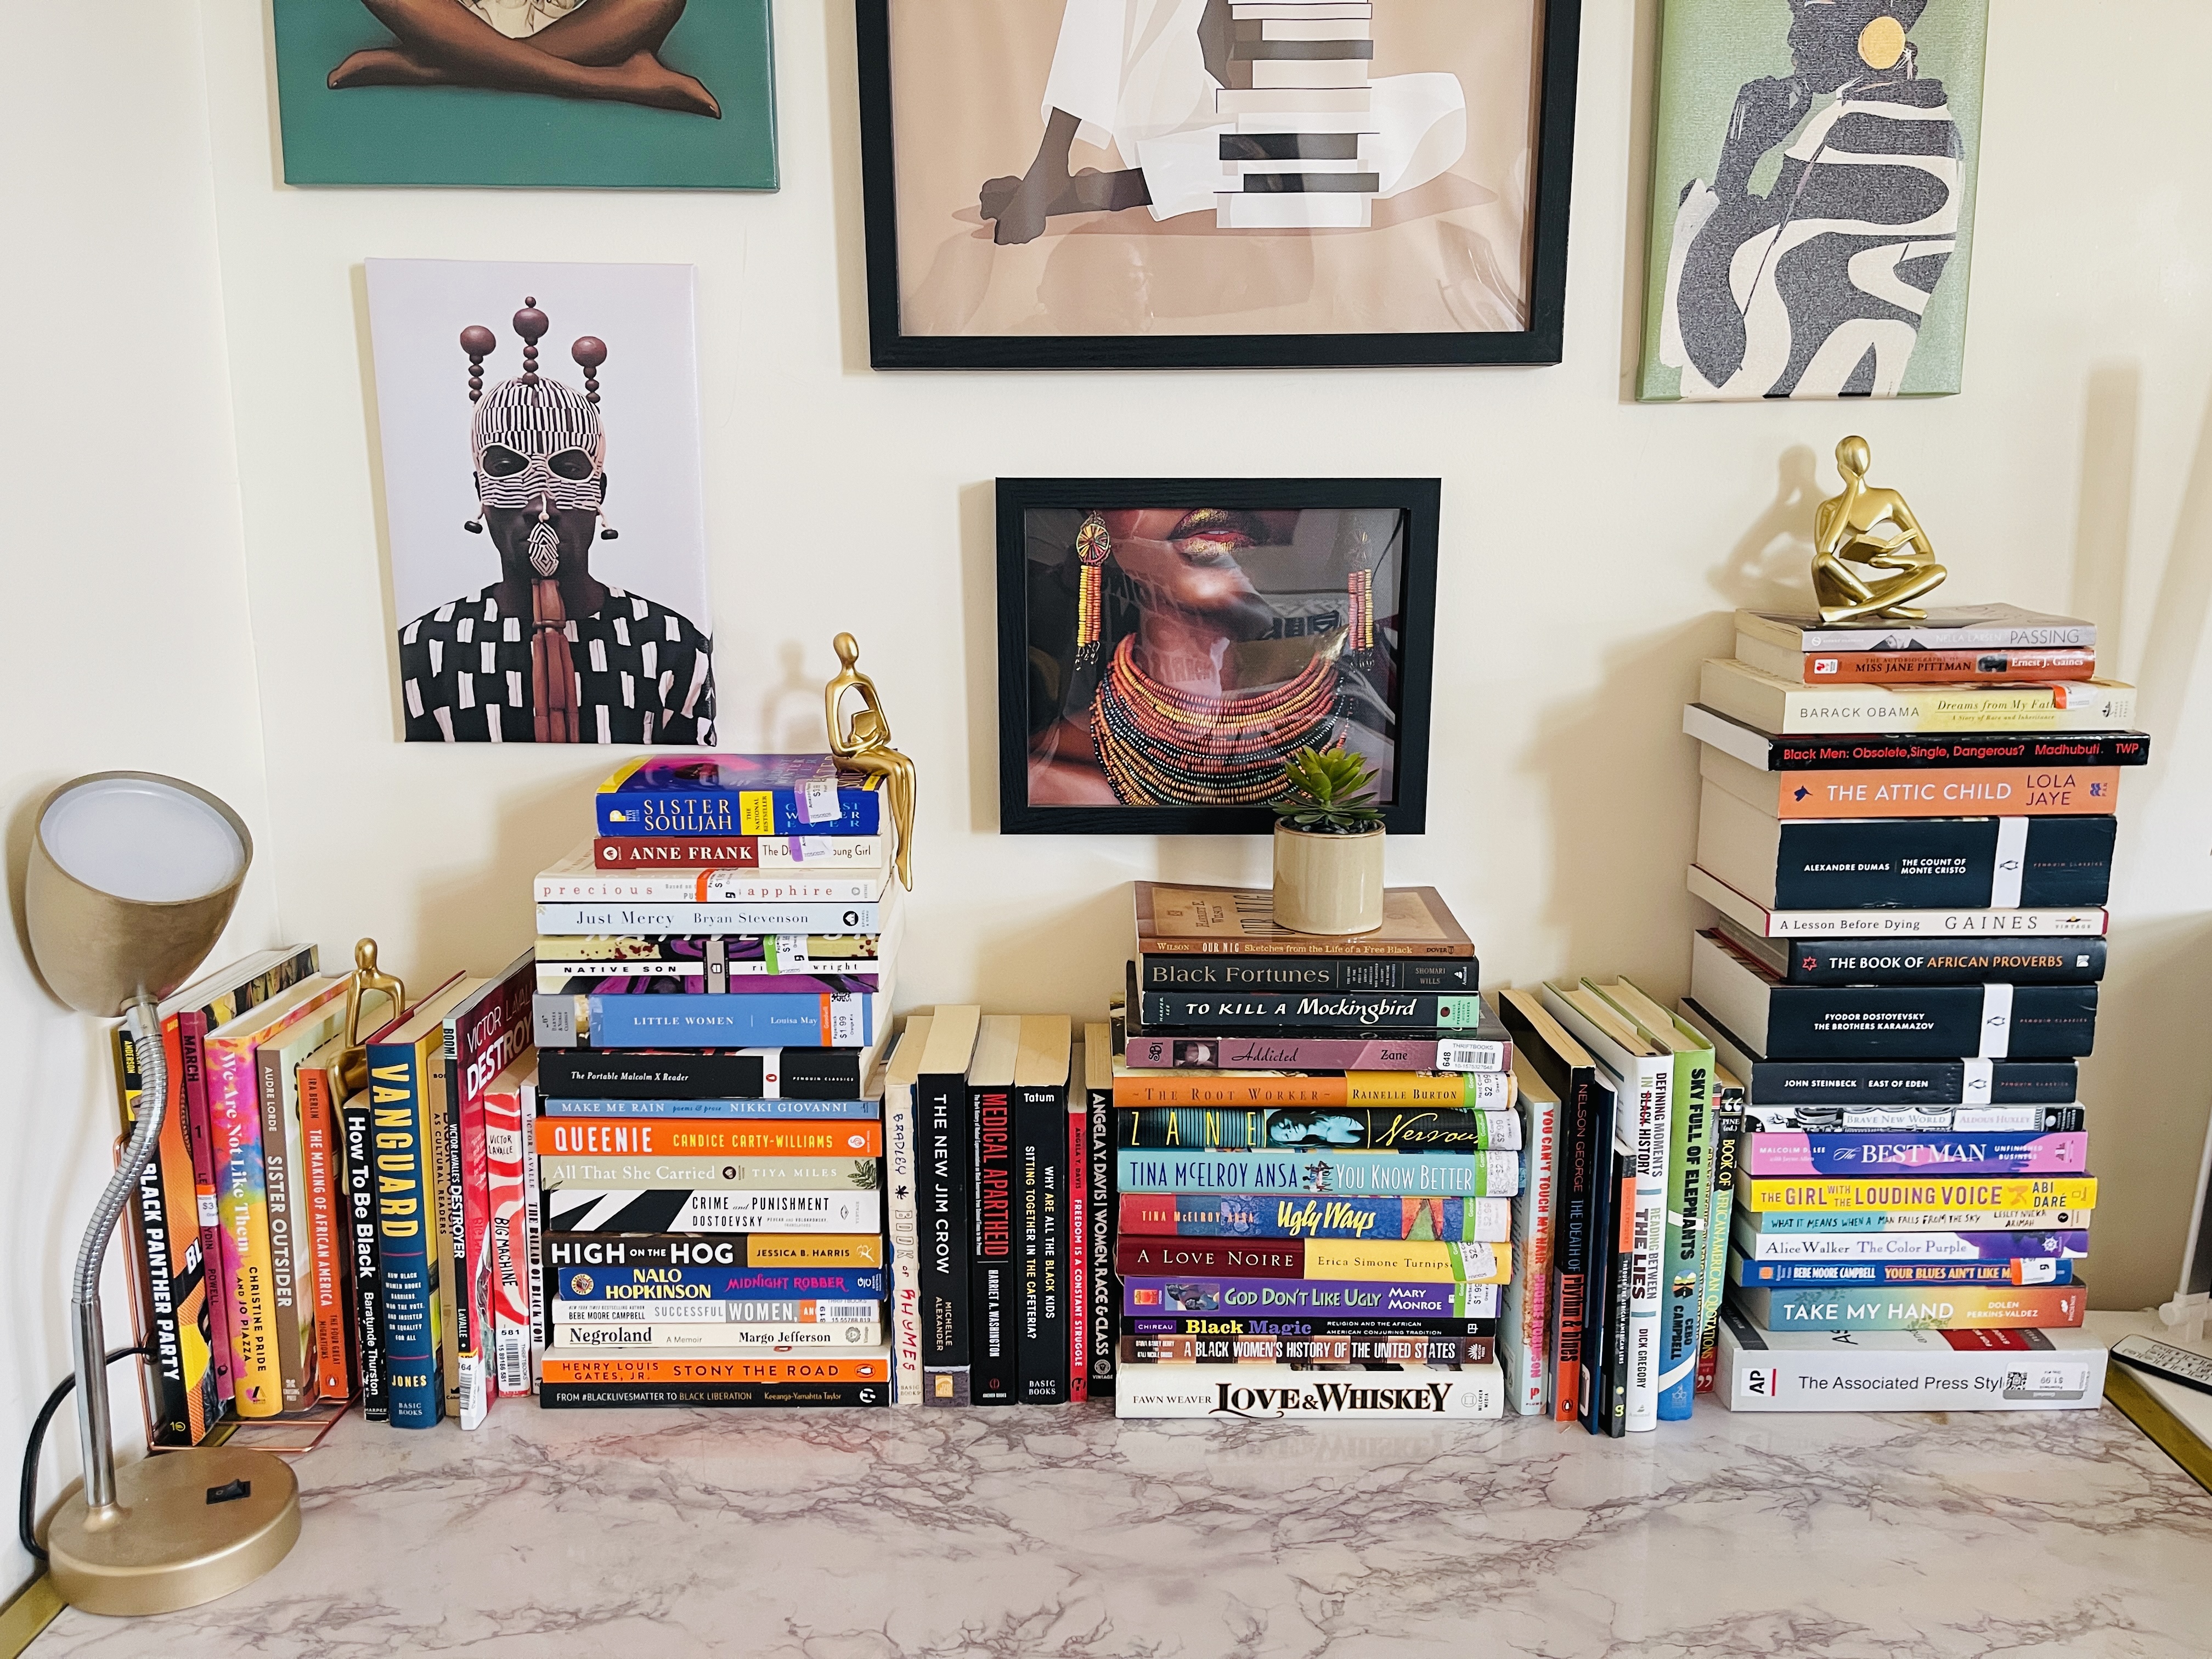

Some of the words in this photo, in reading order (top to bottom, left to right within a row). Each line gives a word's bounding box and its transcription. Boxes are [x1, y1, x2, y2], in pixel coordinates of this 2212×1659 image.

[2010, 630, 2079, 644] PASSING
[1801, 707, 1861, 718] BARACK
[1866, 706, 1919, 716] OBAMA
[2027, 775, 2075, 788] LOLA
[1827, 785, 1867, 801] THE
[1875, 784, 1935, 800] ATTIC
[1943, 783, 2012, 800] CHILD
[2026, 791, 2070, 805] JAYE
[644, 799, 730, 814] SISTER
[645, 816, 732, 831] SOULJAH
[630, 847, 681, 860] ANNE
[689, 847, 753, 859] FRANK
[544, 885, 653, 898] precious
[577, 912, 613, 925] Just
[621, 912, 674, 927] Mercy
[694, 913, 732, 926] Bryan
[739, 913, 808, 924] Stevenson
[1780, 921, 1788, 929] A
[1793, 920, 1835, 929] Lesson
[1841, 920, 1879, 929] Before
[1884, 919, 1920, 930] Dying
[1945, 916, 2039, 930] GAINES
[1829, 957, 1856, 968] THE
[1859, 957, 1900, 968] BOOK
[1904, 957, 1924, 968] OF
[1927, 956, 1989, 968] AFRICAN
[1992, 955, 2063, 968] PROVERBS
[1153, 967, 1217, 981] Black
[1226, 967, 1330, 982] Fortunes
[1186, 1003, 1210, 1014] TO
[1219, 1003, 1267, 1014] KILL
[1275, 1003, 1286, 1014] A
[1297, 999, 1418, 1024] Mockingbird
[634, 1017, 680, 1025] LITTLE
[685, 1017, 734, 1025] WOMEN
[1877, 1022, 1934, 1030] KARAMAZOV
[182, 1035, 199, 1082] MARCH
[221, 1052, 235, 1082] We
[571, 1071, 585, 1080] The
[588, 1071, 618, 1081] Portable
[620, 1072, 651, 1081] Malcolm
[654, 1073, 660, 1081] X
[663, 1073, 689, 1081] Reader
[223, 1090, 238, 1119] Are
[1024, 1093, 1054, 1102] Tatum
[934, 1094, 947, 1128] THE
[983, 1094, 1007, 1163] MEDICAL
[226, 1126, 240, 1154] Not
[348, 1117, 365, 1161] How
[555, 1126, 653, 1152] QUEENIE
[673, 1134, 724, 1147] CANDICE
[732, 1134, 833, 1148] CARTY-WILLIAMS
[371, 1063, 419, 1237] VANGUARD
[934, 1136, 948, 1177] NEW
[1862, 1146, 1921, 1163] BEST
[1928, 1144, 1987, 1163] MAN
[230, 1160, 245, 1199] Like
[352, 1165, 369, 1188] To
[552, 1166, 578, 1180] All
[582, 1166, 617, 1179] That
[623, 1166, 651, 1180] She
[656, 1166, 715, 1180] Carried
[268, 1156, 284, 1214] SISTER
[1828, 1186, 1850, 1195] WITH
[2032, 1182, 2054, 1194] ABI
[692, 1197, 729, 1210] CRIME
[752, 1197, 829, 1211] PUNISHMENT
[935, 1184, 949, 1212] JIM
[1762, 1193, 1781, 1203] THE
[1785, 1189, 1827, 1205] GIRL
[1834, 1198, 1851, 1206] THE
[1855, 1188, 1936, 1205] LOUDING
[1942, 1187, 2002, 1205] VOICE
[354, 1193, 371, 1218] Be
[984, 1169, 1009, 1256] APARTHEID
[234, 1202, 250, 1251] Them
[494, 1217, 509, 1236] BIG
[693, 1215, 762, 1227] DOSTOEVSKY
[1094, 1209, 1107, 1266] WOMEN,
[356, 1225, 374, 1278] Black
[551, 1243, 624, 1264] HIGH
[630, 1249, 644, 1257] ON
[647, 1249, 666, 1257] THE
[671, 1243, 733, 1264] HOG
[935, 1220, 949, 1273] CROW
[1765, 1241, 1799, 1254] Alice
[1803, 1241, 1849, 1254] Walker
[1858, 1242, 1881, 1254] The
[1886, 1241, 1921, 1254] Color
[1926, 1240, 1966, 1254] Purple
[146, 1228, 172, 1314] PANTHER
[272, 1222, 292, 1307] OUTSIDER
[496, 1240, 517, 1286] MACHINE
[633, 1268, 681, 1284] NALO
[606, 1283, 712, 1299] HOPKINSON
[1095, 1269, 1108, 1304] RACE
[1098, 1306, 1107, 1316] &
[1784, 1304, 1838, 1320] TAKE
[1847, 1305, 1881, 1320] MY
[1888, 1304, 1954, 1319] HAND
[1186, 1320, 1243, 1334] Black
[1249, 1320, 1311, 1336] Magic
[569, 1328, 652, 1345] Negroland
[739, 1331, 774, 1345] Margo
[777, 1331, 831, 1343] Jefferson
[1096, 1318, 1108, 1355] CLASS
[1639, 1329, 1648, 1348] DICK
[157, 1319, 180, 1380] PARTY
[1184, 1342, 1192, 1357] A
[1195, 1342, 1228, 1357] BLACK
[1233, 1341, 1283, 1358] WOMEN'S
[1288, 1343, 1331, 1358] HISTORY
[1334, 1343, 1348, 1358] OF
[1352, 1344, 1370, 1358] THE
[1374, 1344, 1410, 1358] UNITED
[1415, 1344, 1455, 1358] STATES
[674, 1365, 733, 1376] STONY
[743, 1365, 777, 1376] THE
[789, 1365, 838, 1376] ROAD
[1636, 1350, 1647, 1388] GREGORY
[392, 1375, 427, 1387] JONES
[1799, 1376, 1828, 1390] The
[1833, 1376, 1918, 1390] Associated
[1925, 1376, 1970, 1389] Press
[1133, 1396, 1163, 1404] FAWN
[1166, 1396, 1211, 1404] WEAVER
